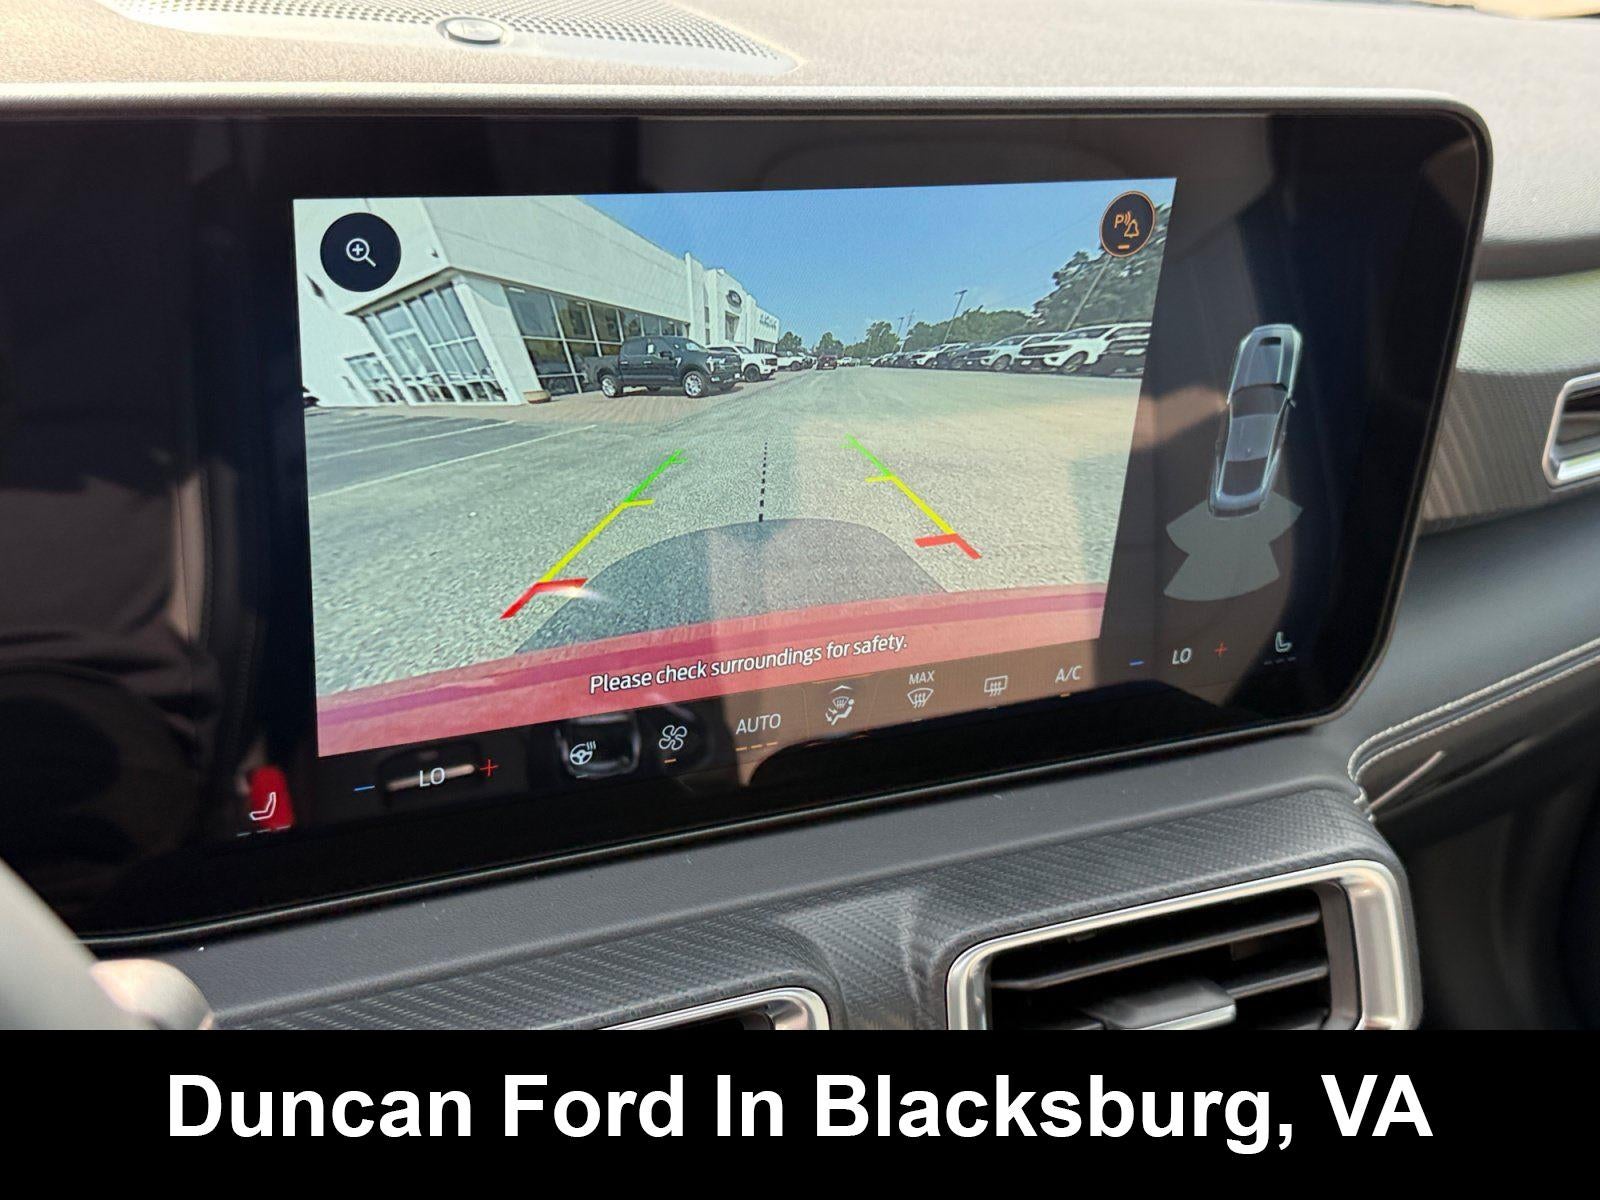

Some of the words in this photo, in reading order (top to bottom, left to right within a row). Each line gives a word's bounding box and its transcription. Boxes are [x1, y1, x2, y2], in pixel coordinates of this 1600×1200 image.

[590, 674, 652, 694] Please
[656, 660, 707, 684] check
[710, 647, 822, 676] surroundings
[826, 641, 850, 660] for
[853, 634, 908, 655] safety.
[1172, 647, 1192, 665] LO
[909, 670, 935, 685] MAX
[1055, 665, 1082, 684] A/C
[736, 713, 781, 735] AUTO
[419, 767, 446, 787] LO
